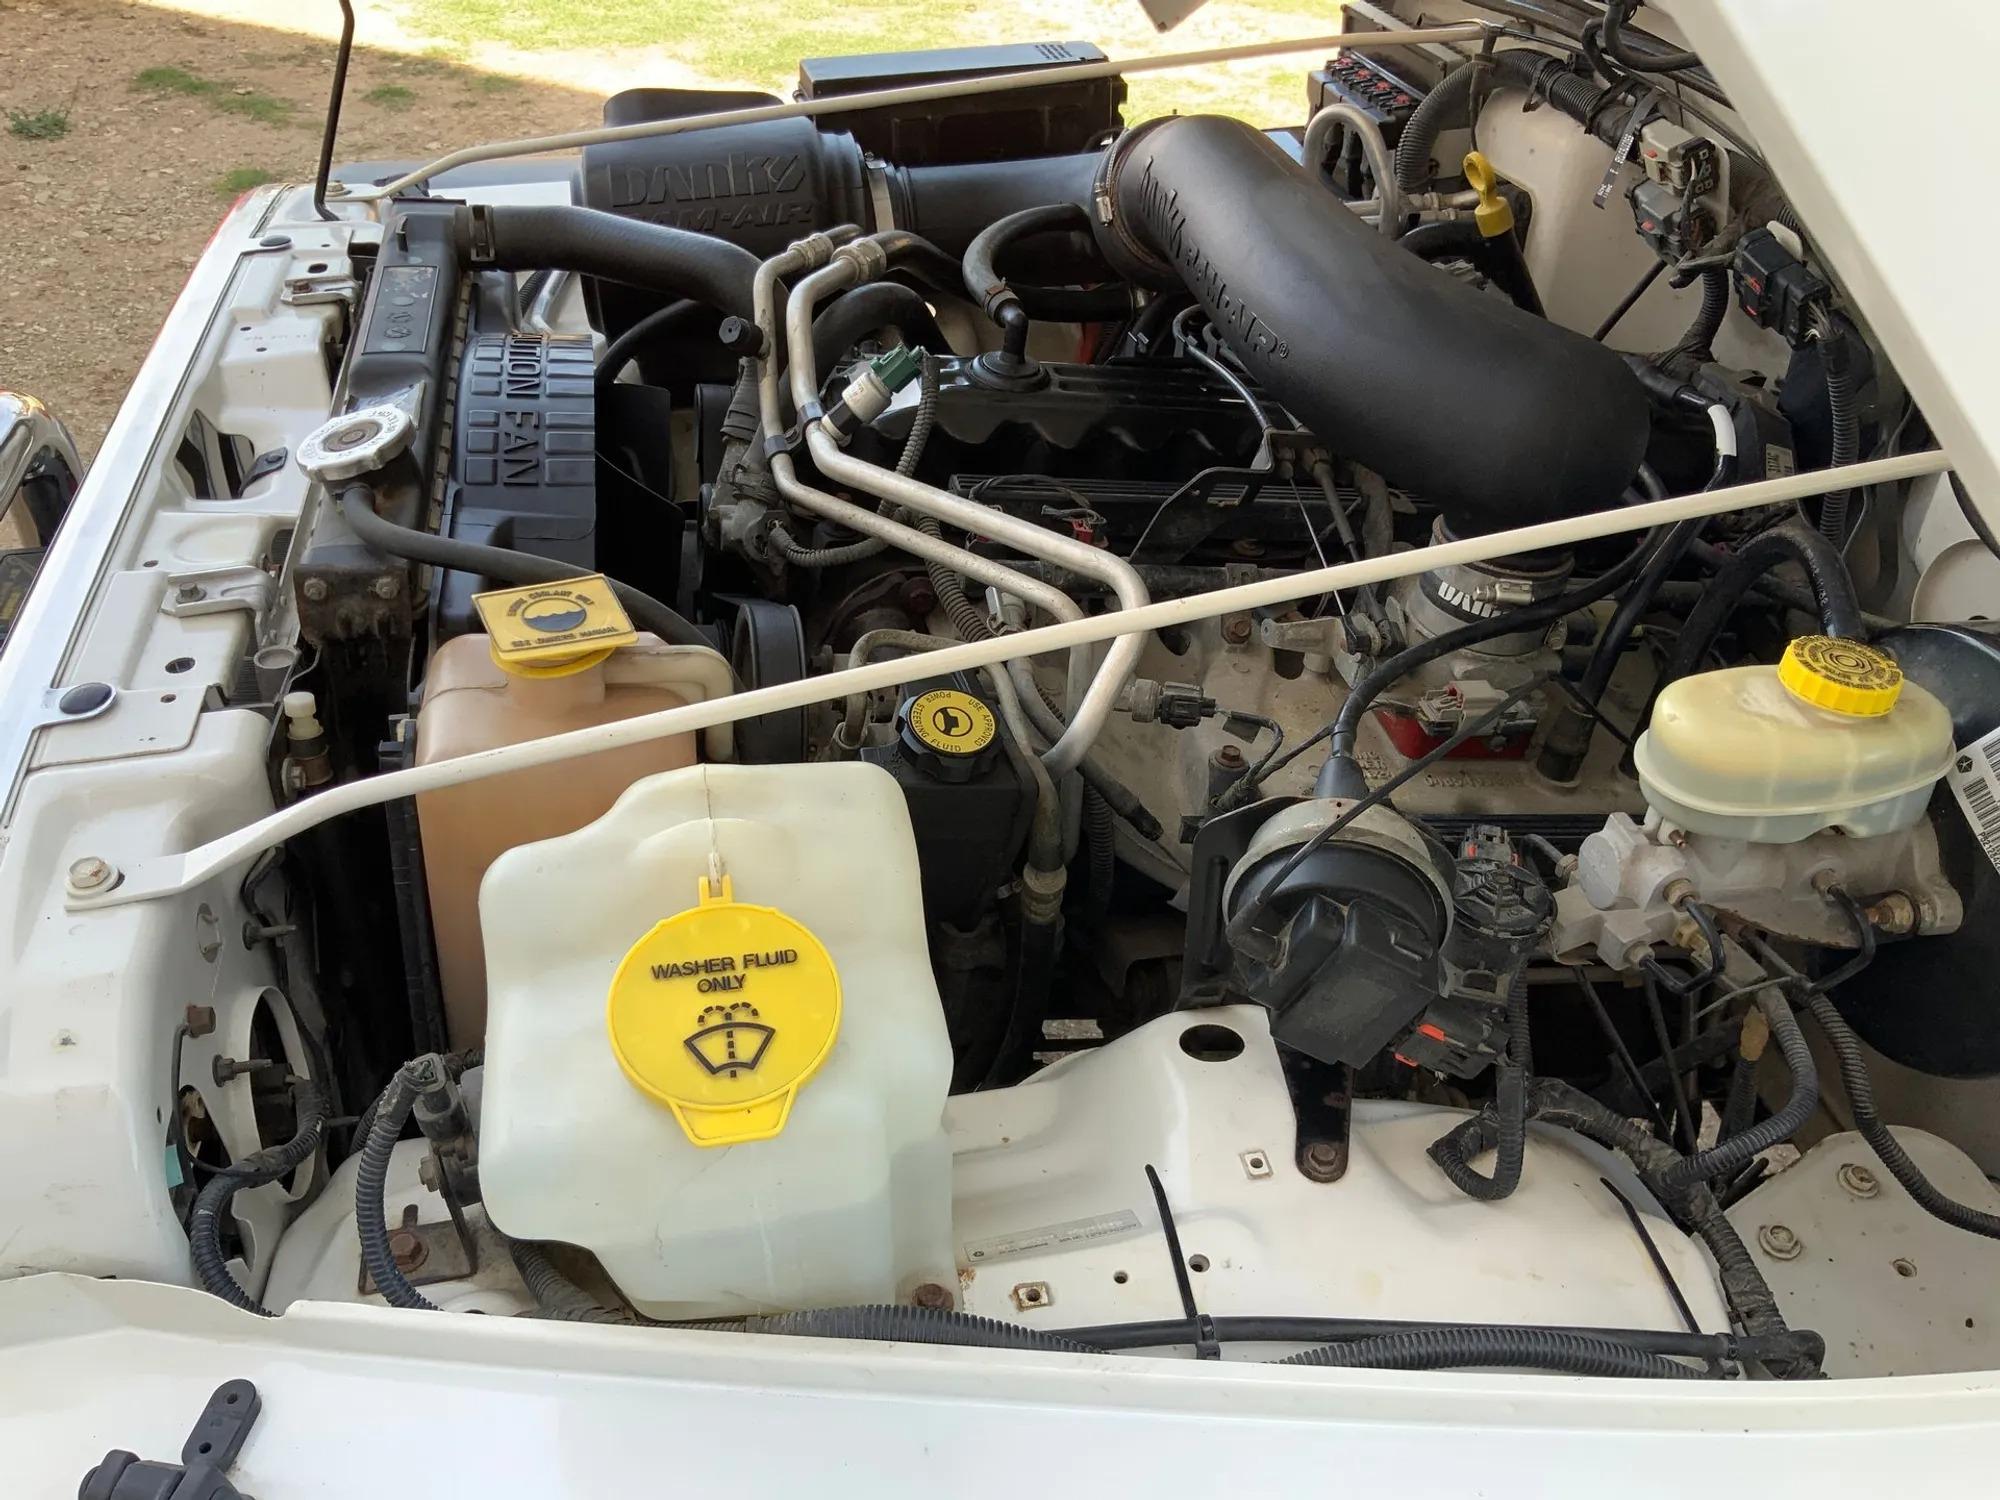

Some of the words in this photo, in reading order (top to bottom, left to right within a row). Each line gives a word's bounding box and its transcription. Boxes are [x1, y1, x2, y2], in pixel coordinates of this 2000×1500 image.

[507, 333, 542, 399] AUTION
[503, 410, 540, 487] FAN
[926, 691, 952, 703] POWER
[967, 698, 985, 712] USE
[912, 702, 930, 738] STEERING
[974, 714, 994, 746] APPROVED
[930, 738, 962, 752] FLUID
[651, 957, 736, 980] WASHER
[743, 949, 798, 969] FLUID
[697, 974, 746, 993] ONLY
